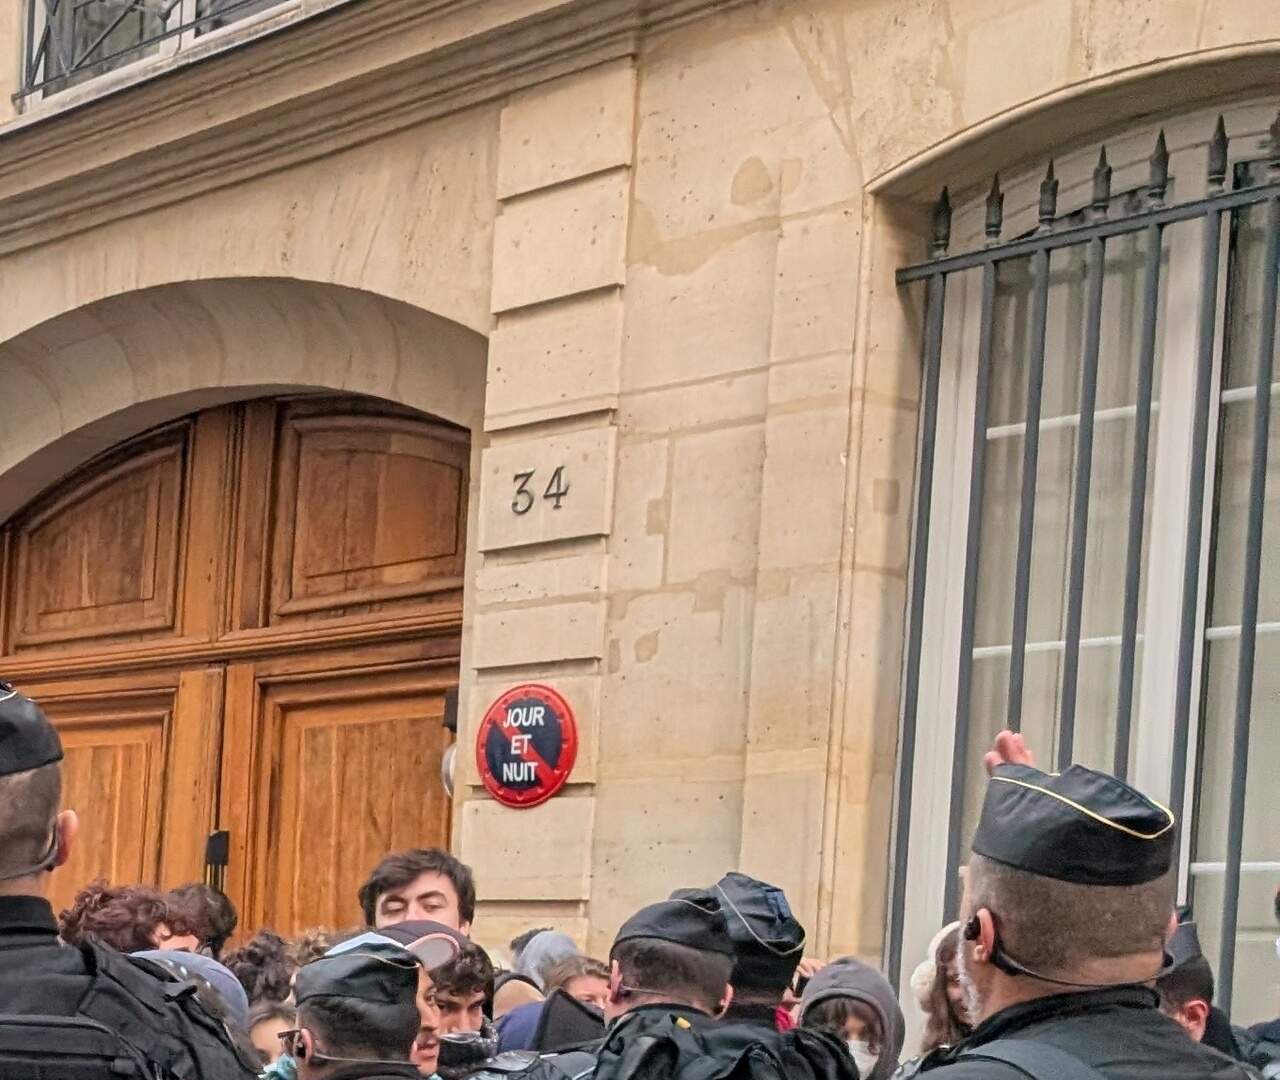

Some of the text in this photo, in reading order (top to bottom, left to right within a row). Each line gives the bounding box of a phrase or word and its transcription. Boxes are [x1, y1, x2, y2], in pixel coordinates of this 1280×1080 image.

[511, 465, 570, 515] 34
[503, 706, 545, 728] JOUR
[511, 734, 532, 755] ET
[503, 762, 538, 782] NUIT
